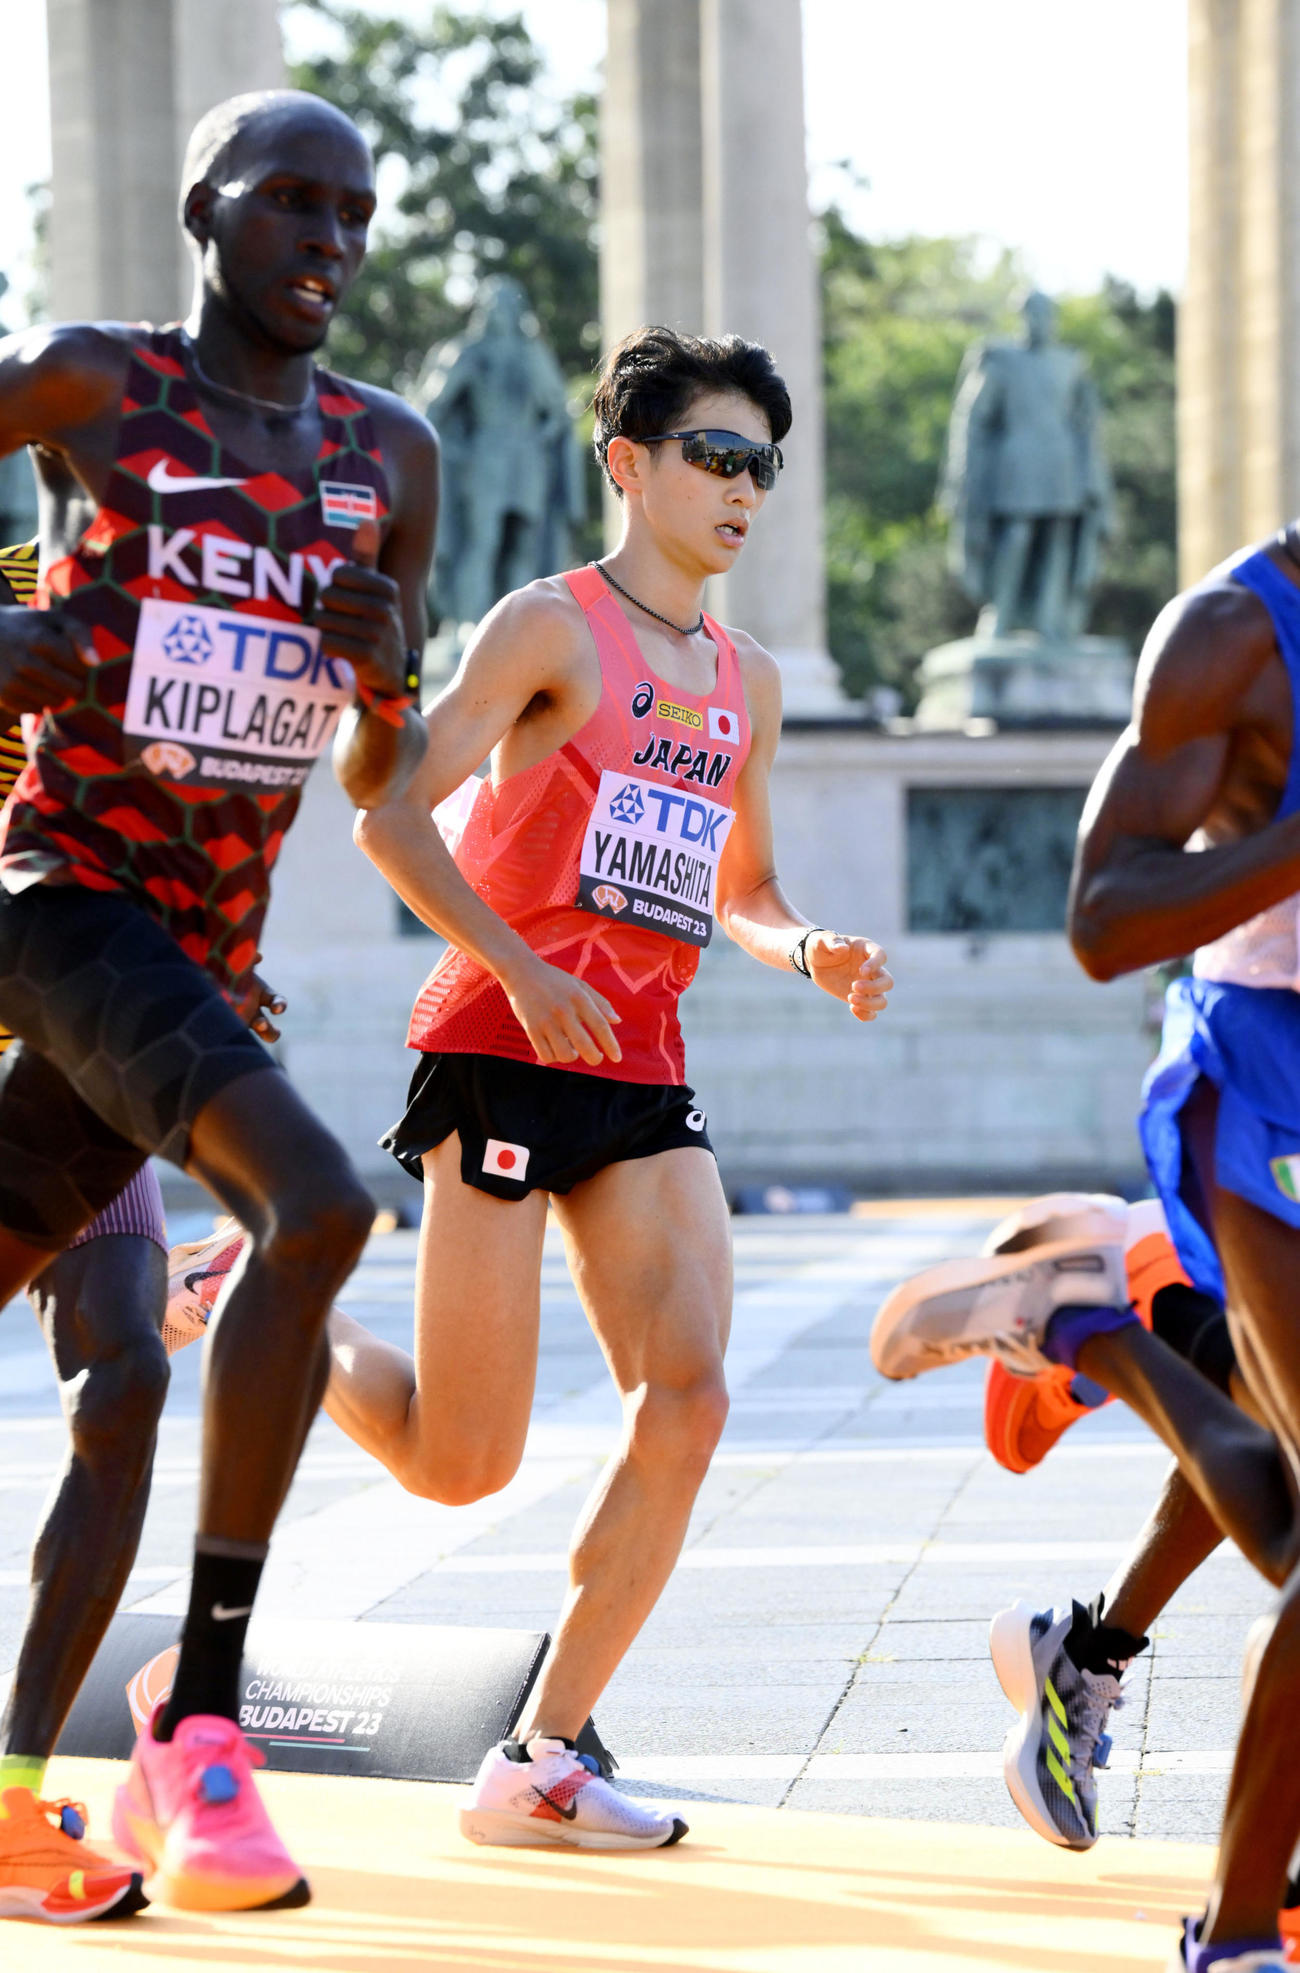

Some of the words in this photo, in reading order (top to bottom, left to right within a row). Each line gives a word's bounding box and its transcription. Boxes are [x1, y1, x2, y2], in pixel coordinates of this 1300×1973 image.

[147, 524, 347, 609] KENY
[144, 676, 339, 750] KIPLAGAT
[658, 703, 702, 727] SEIKO
[633, 734, 732, 788] JAPAN
[647, 788, 728, 852] TDK
[594, 830, 712, 908] YAMASHITA
[239, 1705, 354, 1733] BUDAPEST
[352, 1711, 383, 1735] 23
[245, 1680, 393, 1707] CHAMPIONSHIPS
